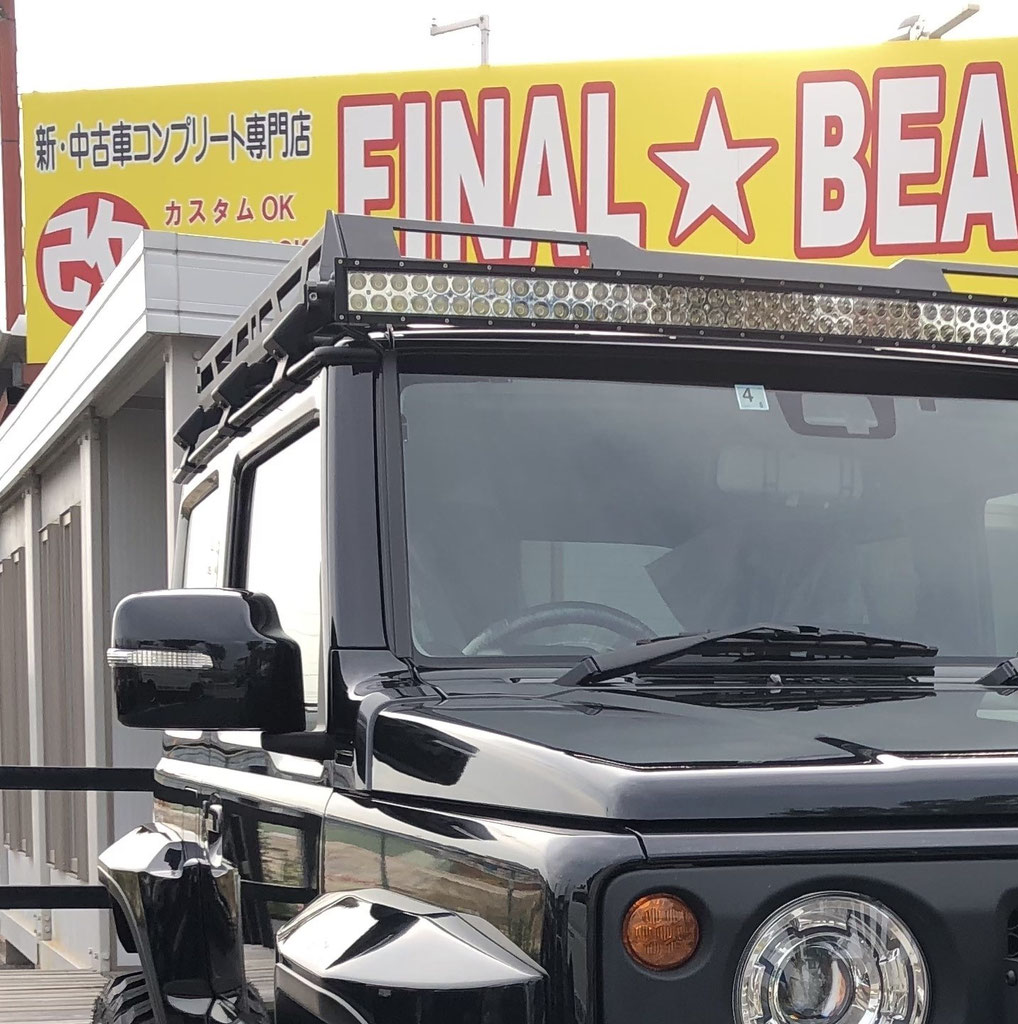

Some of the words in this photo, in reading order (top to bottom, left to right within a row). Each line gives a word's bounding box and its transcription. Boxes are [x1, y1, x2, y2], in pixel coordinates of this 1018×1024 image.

[35, 111, 312, 171] 新・中古車コンプリート専門店
[338, 81, 646, 266] FINAL
[165, 199, 254, 225] カスタム
[261, 195, 296, 221] OK
[742, 387, 754, 403] 4
